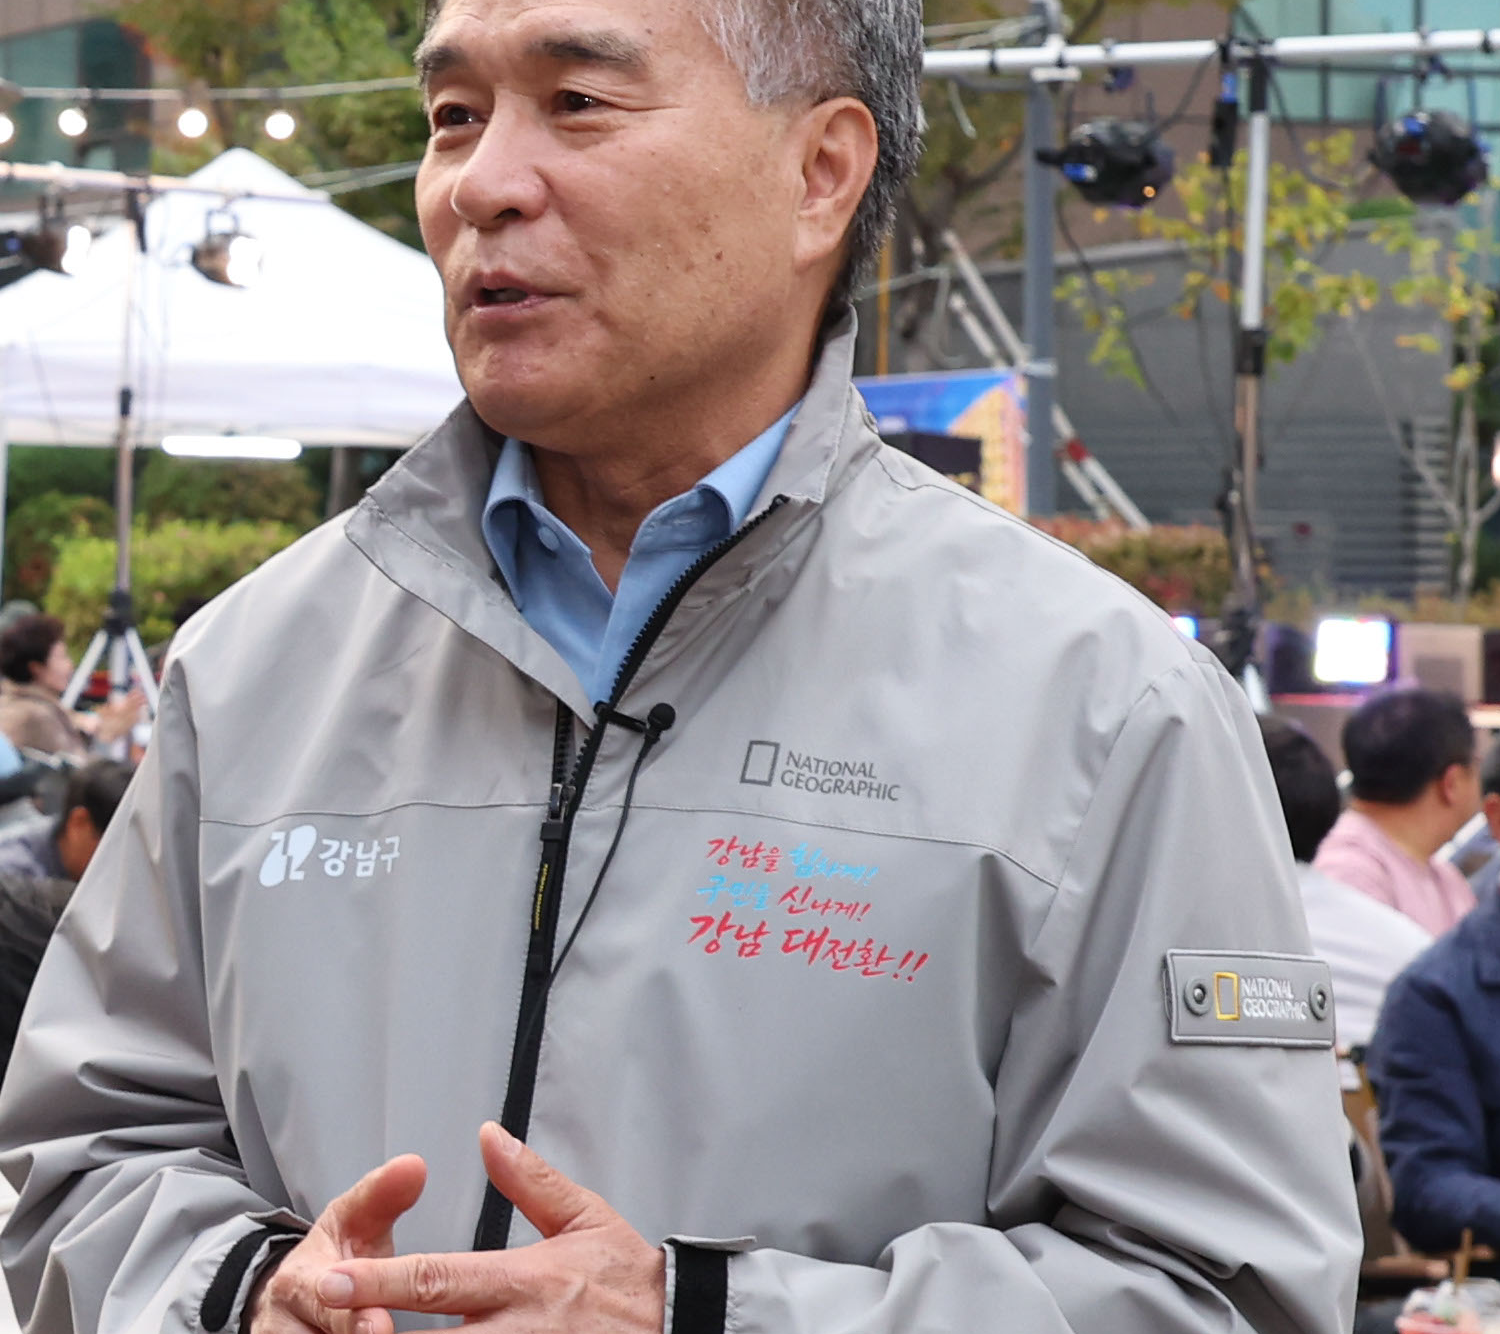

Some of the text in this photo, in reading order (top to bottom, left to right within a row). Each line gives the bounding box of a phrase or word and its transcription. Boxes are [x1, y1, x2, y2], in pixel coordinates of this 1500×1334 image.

[786, 750, 877, 779] NATIONAL
[780, 769, 901, 801] GEOGRAPHIC
[318, 835, 400, 878] 강남구
[706, 835, 880, 887] 강남을 힘차게!
[696, 875, 872, 922] 구민을 신나게!
[687, 910, 930, 983] 강남 대전환!!
[1240, 977, 1294, 1000] NATIONAL
[1241, 998, 1308, 1020] GEOGRAPHIC
